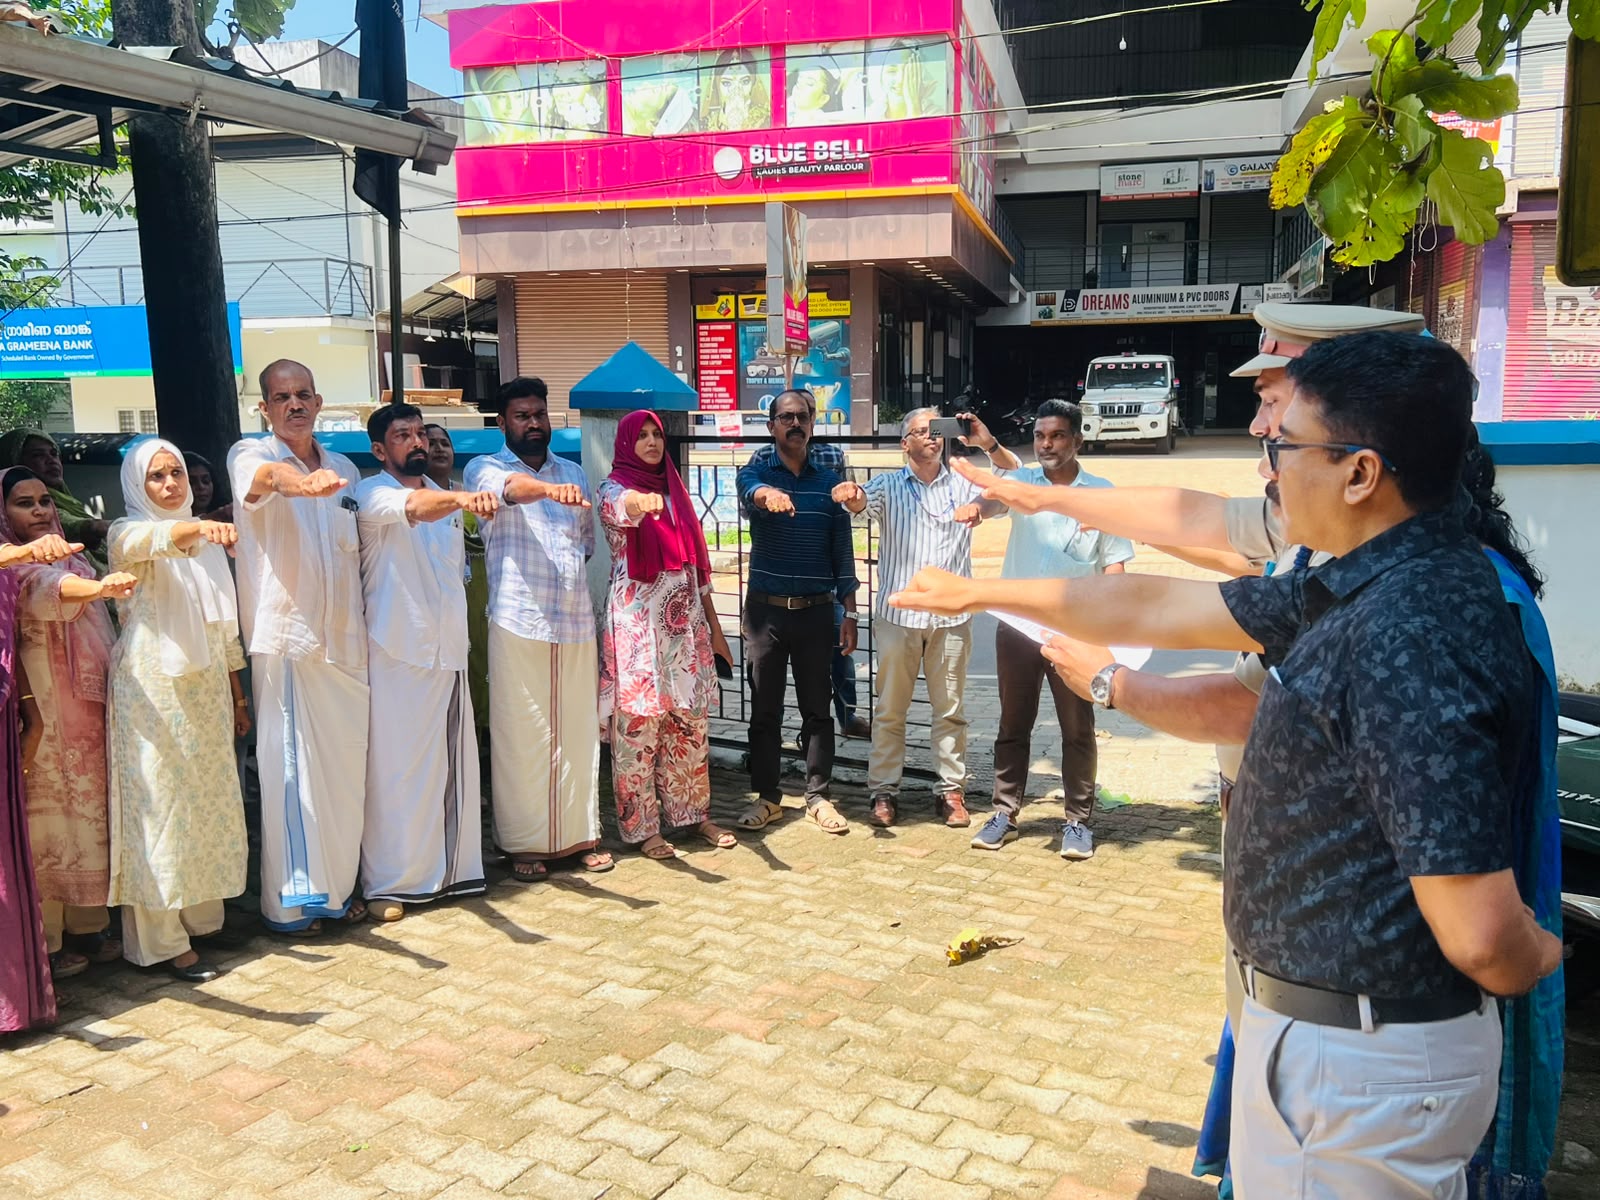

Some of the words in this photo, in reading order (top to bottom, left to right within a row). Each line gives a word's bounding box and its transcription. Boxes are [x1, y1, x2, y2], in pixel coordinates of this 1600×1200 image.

[750, 142, 807, 164] BLUE
[813, 139, 870, 160] BELL
[756, 167, 787, 175] LADIES
[788, 165, 822, 173] BEAUTY
[824, 163, 864, 171] PARLOUR
[1118, 173, 1142, 181] stone
[1082, 294, 1130, 310] DREAMS
[1132, 293, 1177, 305] ALUMINIUM
[1179, 292, 1184, 302] &
[1186, 291, 1201, 302] PVC
[1203, 290, 1230, 301] DOORS
[7, 340, 61, 352] GRAMEENA
[63, 340, 93, 350] BANK
[56, 354, 62, 362] By
[63, 353, 94, 361] Government
